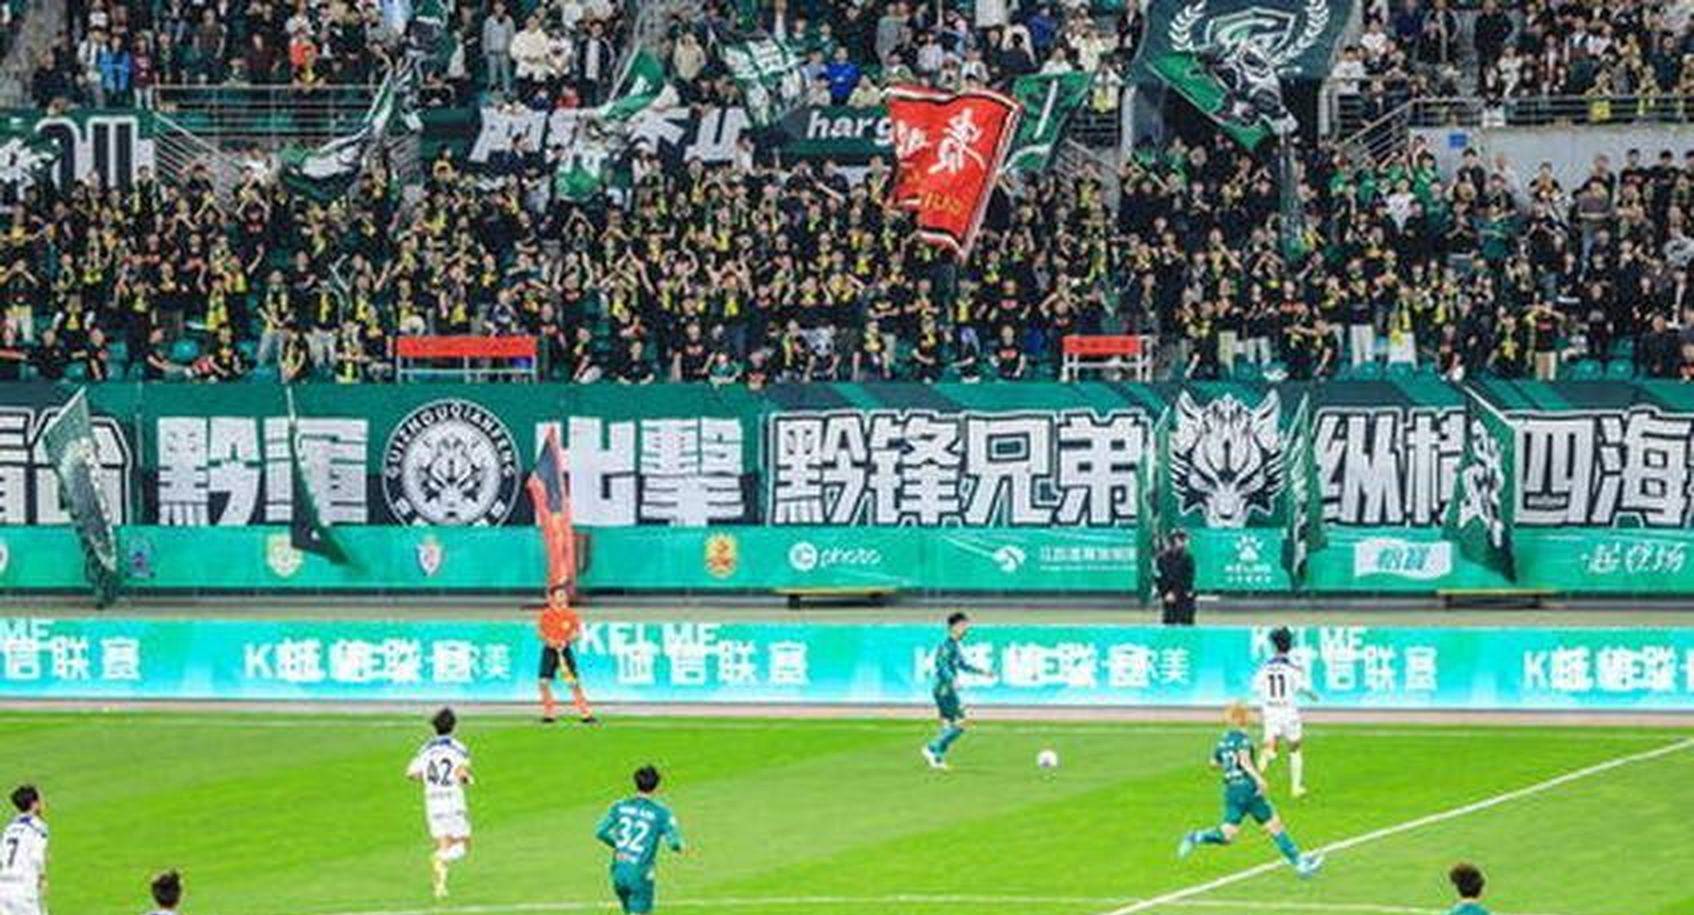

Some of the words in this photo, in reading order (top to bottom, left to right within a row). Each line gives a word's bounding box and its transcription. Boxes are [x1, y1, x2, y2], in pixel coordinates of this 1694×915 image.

[773, 411, 1144, 526] 黔锋兄弟
[1268, 673, 1286, 698] 11
[427, 758, 453, 787] 42
[615, 816, 650, 852] 32
